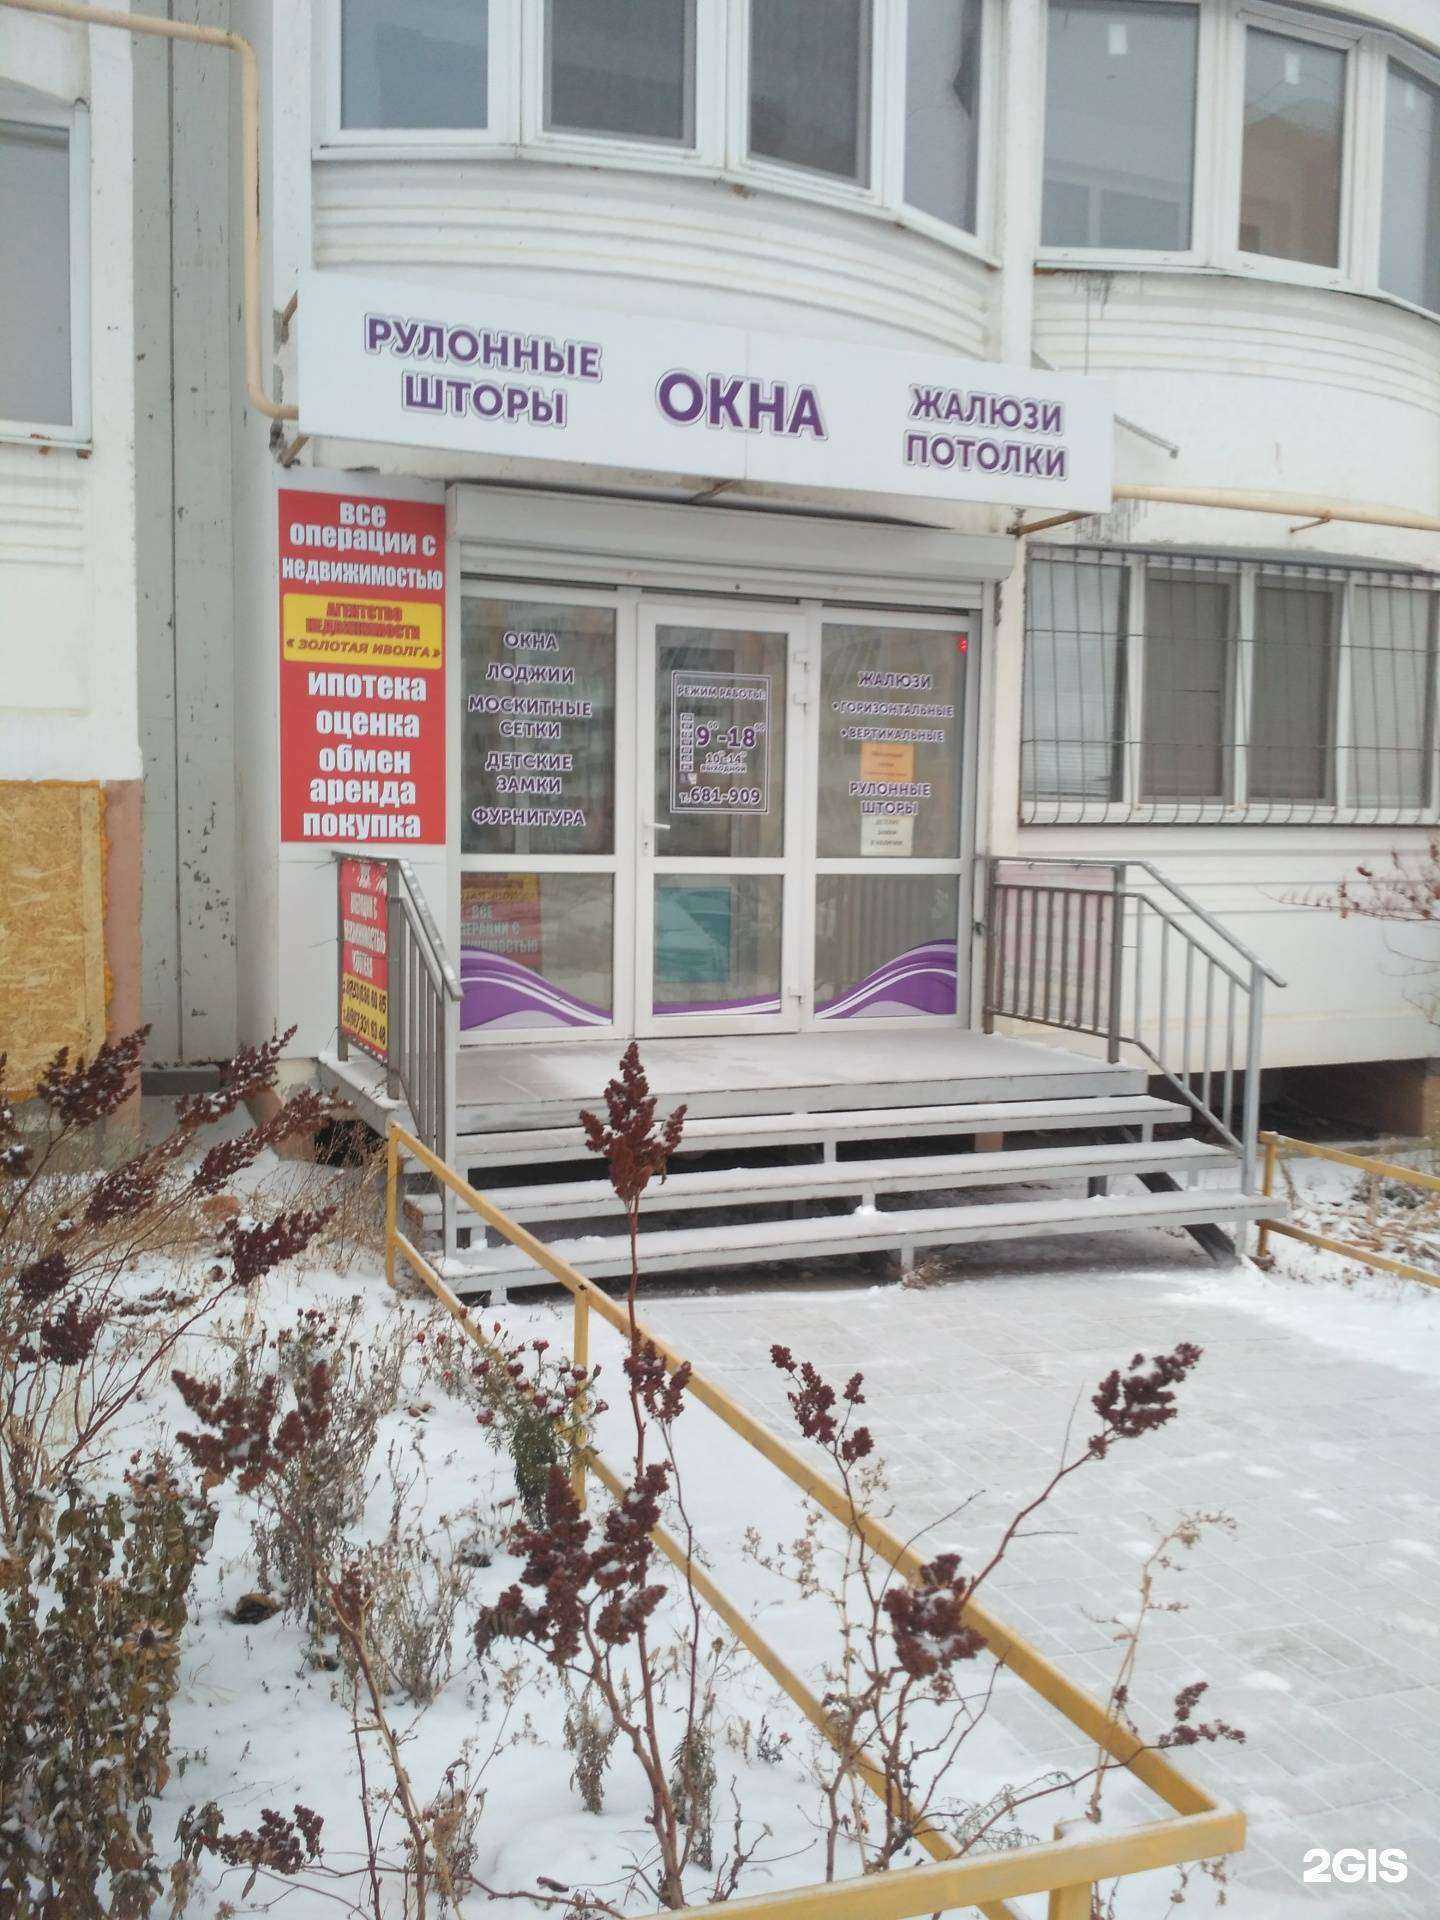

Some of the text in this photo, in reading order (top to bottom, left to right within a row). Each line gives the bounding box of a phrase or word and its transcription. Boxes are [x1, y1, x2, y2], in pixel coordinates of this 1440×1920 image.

[366, 314, 601, 381] РУЛОННЫЕ
[402, 372, 567, 428] ШТОРЫ
[656, 369, 827, 439] ОКНА
[908, 384, 1063, 434] ЖАЛЮЗИ
[904, 430, 1068, 479] ПОТОЛКИ
[290, 523, 436, 557] операции с
[503, 631, 559, 650] ОКНА
[308, 671, 427, 702] ипотека
[485, 663, 575, 684] ЛОДЖИИ
[858, 671, 932, 689] ЖАЛЮЗИ
[468, 695, 593, 718] МОСКИТНЫЕ
[316, 710, 420, 739] оценка
[499, 720, 561, 739] СЕТКИ
[319, 744, 411, 774] обмен
[485, 751, 573, 771] ДЕТСКИЕ
[310, 778, 416, 808] аренда
[496, 776, 562, 795] ЗАМКИ
[849, 781, 932, 798] РУЛОННЫЕ
[472, 807, 586, 826] ФУРНИТУРА
[861, 801, 919, 817] ШТОРЫ
[303, 812, 421, 840] покупка
